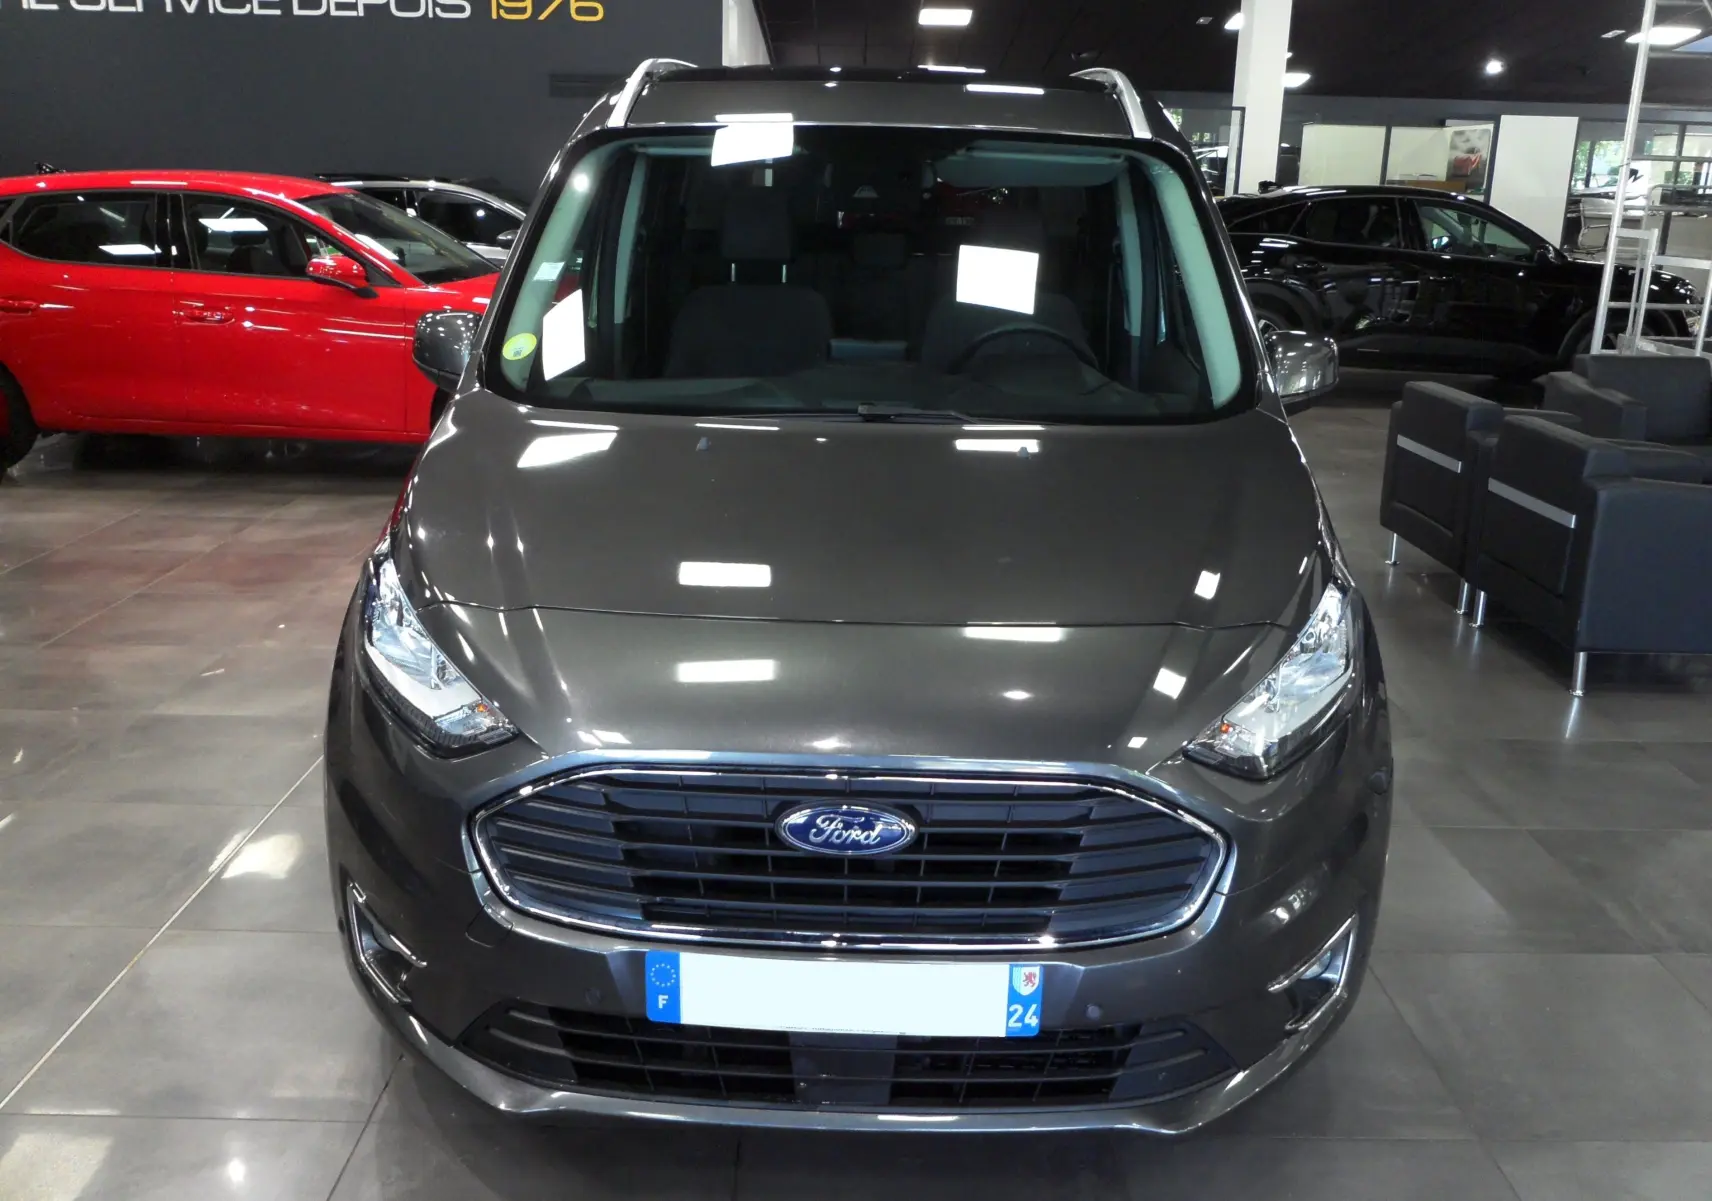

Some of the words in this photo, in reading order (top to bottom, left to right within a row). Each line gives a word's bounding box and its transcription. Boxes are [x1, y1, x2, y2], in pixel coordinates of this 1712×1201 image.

[490, 0, 604, 22] 1976
[808, 814, 881, 845] Ford
[658, 994, 669, 1009] F
[1008, 1003, 1039, 1028] 24
